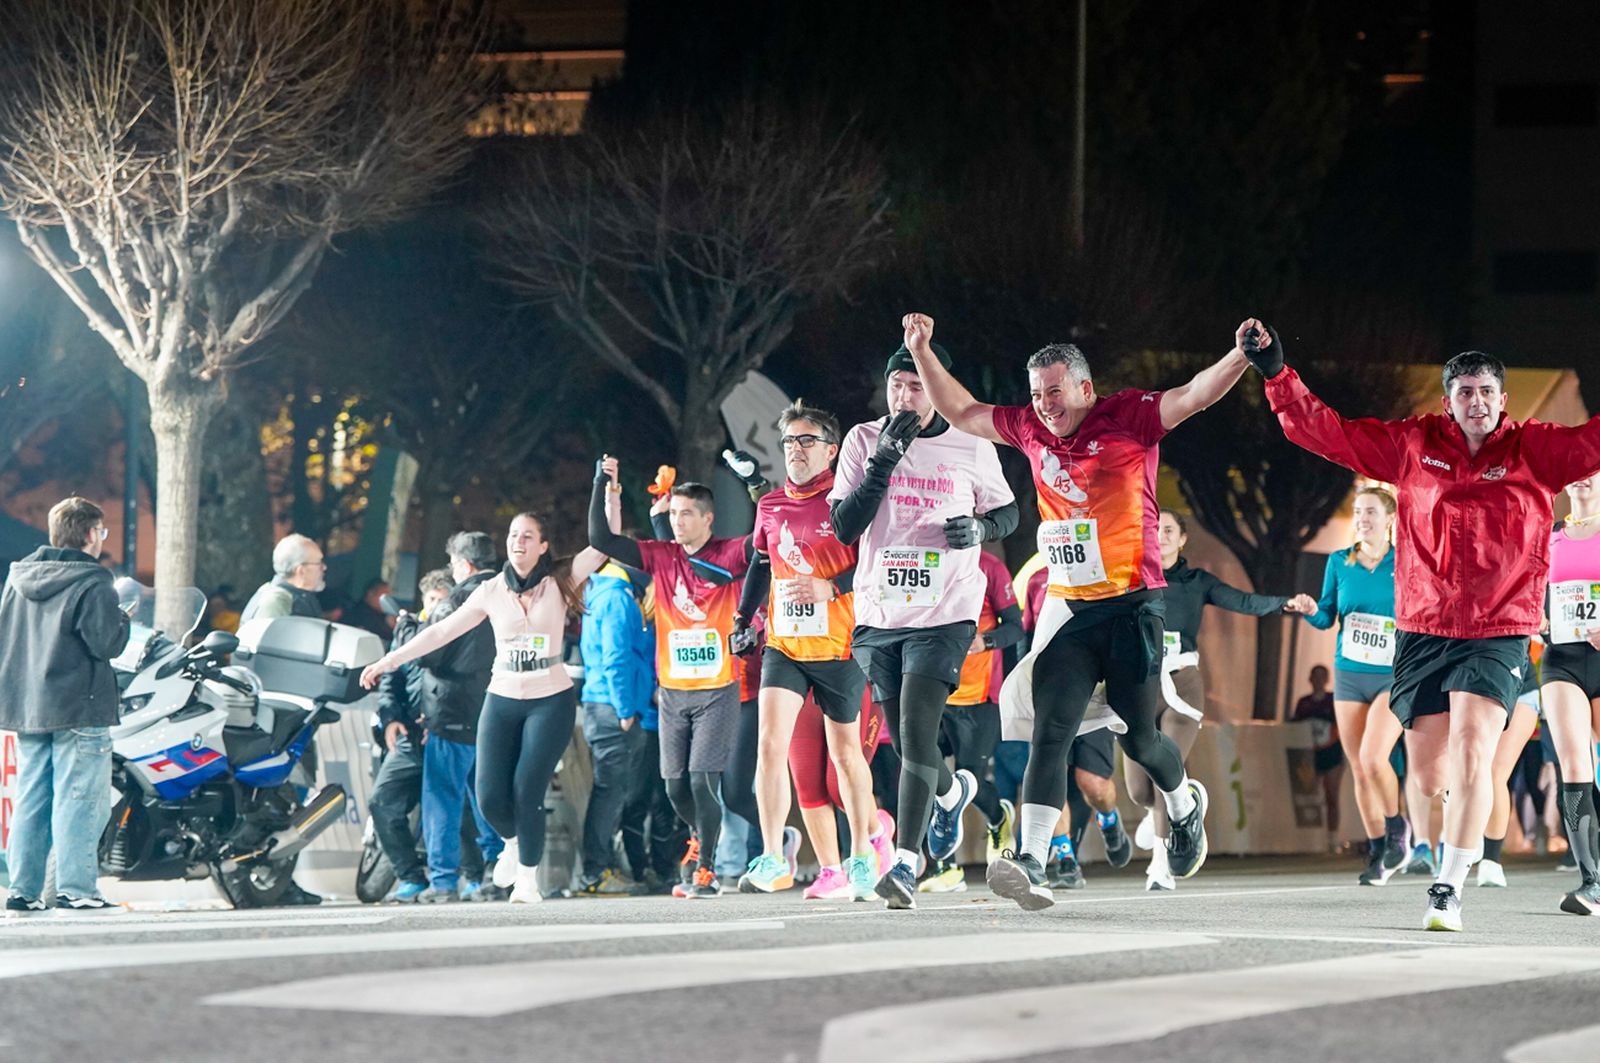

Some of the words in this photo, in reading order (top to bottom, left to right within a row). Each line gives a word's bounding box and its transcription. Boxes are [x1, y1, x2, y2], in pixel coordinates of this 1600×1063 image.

[1422, 455, 1451, 471] Joma
[907, 476, 926, 490] VISTE
[927, 479, 937, 491] DE
[938, 478, 955, 495] ROSA
[1053, 475, 1070, 494] 43
[787, 550, 801, 566] 43
[1048, 543, 1086, 565] 3168
[888, 568, 931, 588] 5795
[783, 601, 815, 617] 1899
[1561, 602, 1597, 621] 1942
[1352, 630, 1388, 649] 6905
[676, 647, 716, 662] 13546
